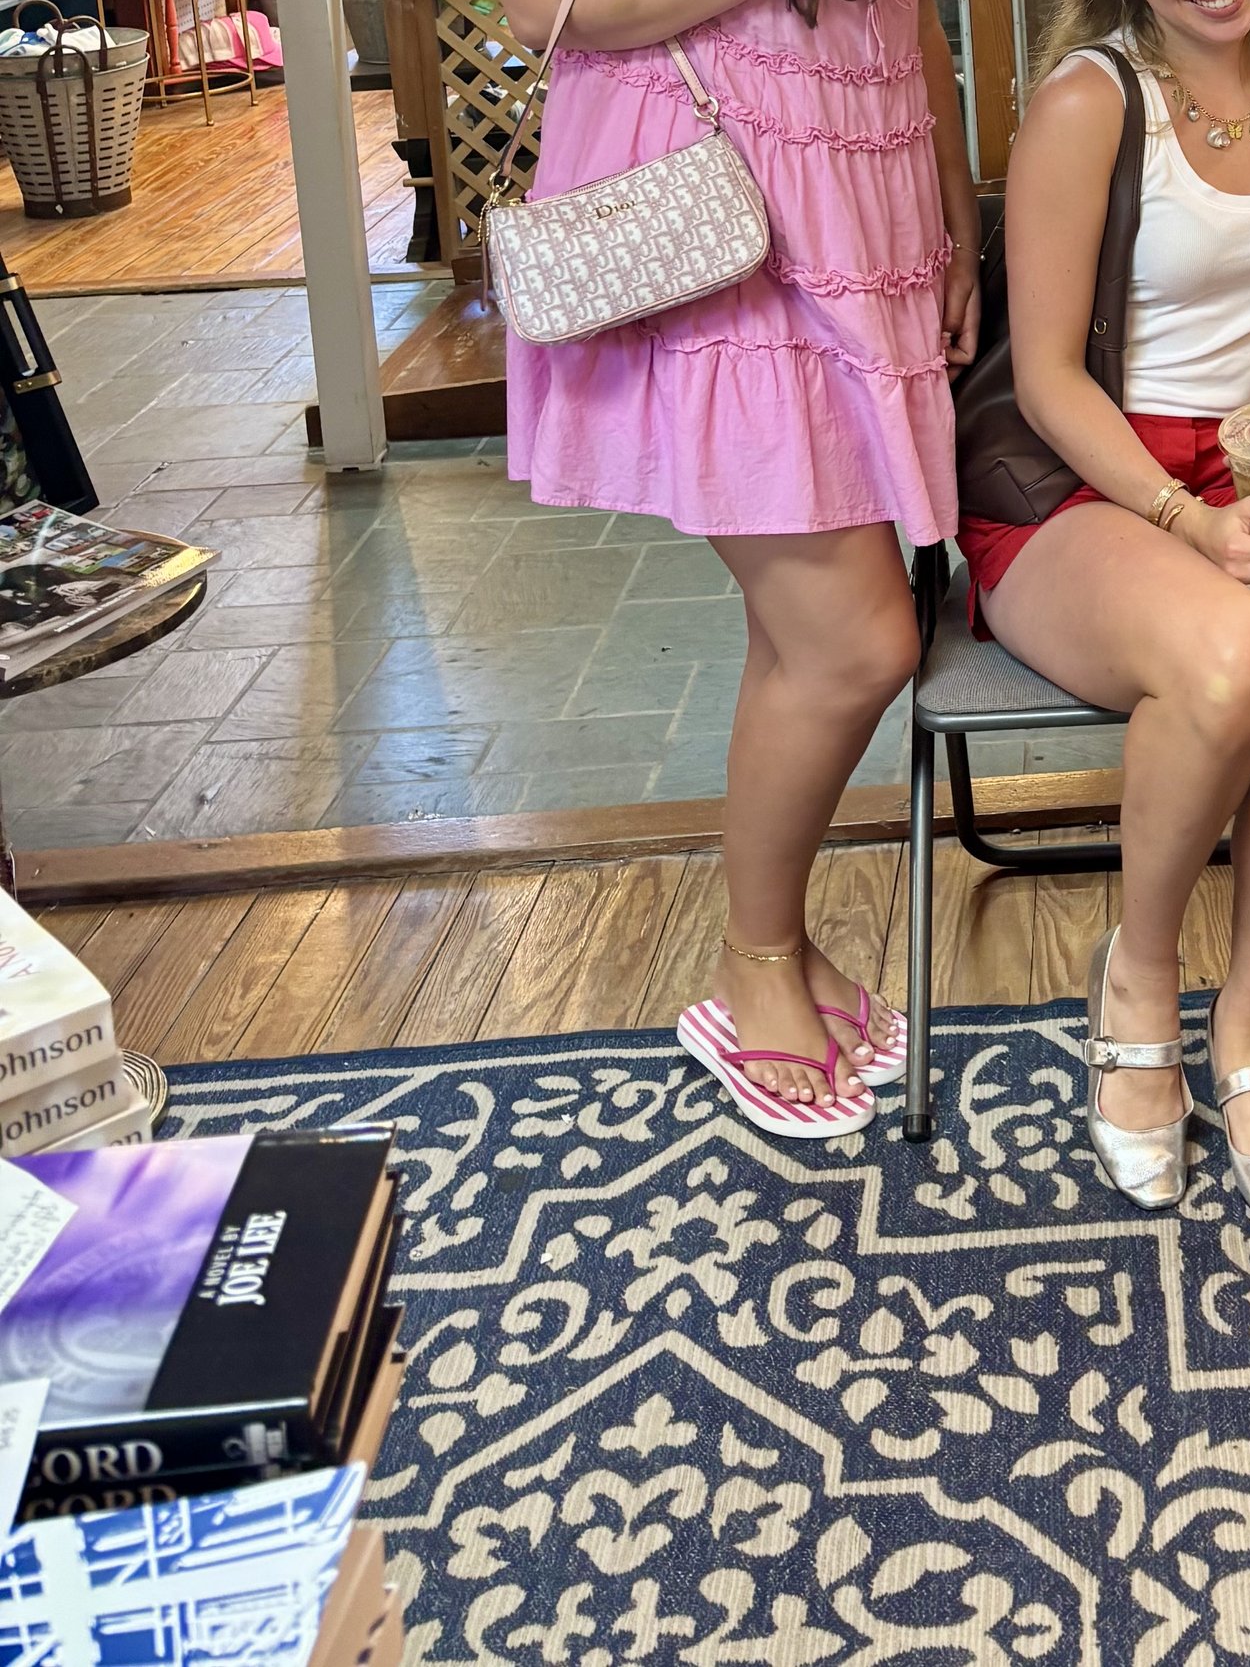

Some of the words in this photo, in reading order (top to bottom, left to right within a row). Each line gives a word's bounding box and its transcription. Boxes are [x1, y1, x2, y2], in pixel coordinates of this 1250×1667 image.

[592, 199, 637, 220] Dior
[203, 1245, 234, 1287] NOVEL
[221, 1225, 241, 1242] BY
[236, 1210, 288, 1256] LEE
[216, 1257, 271, 1307] JOE
[33, 1440, 164, 1484] ORD
